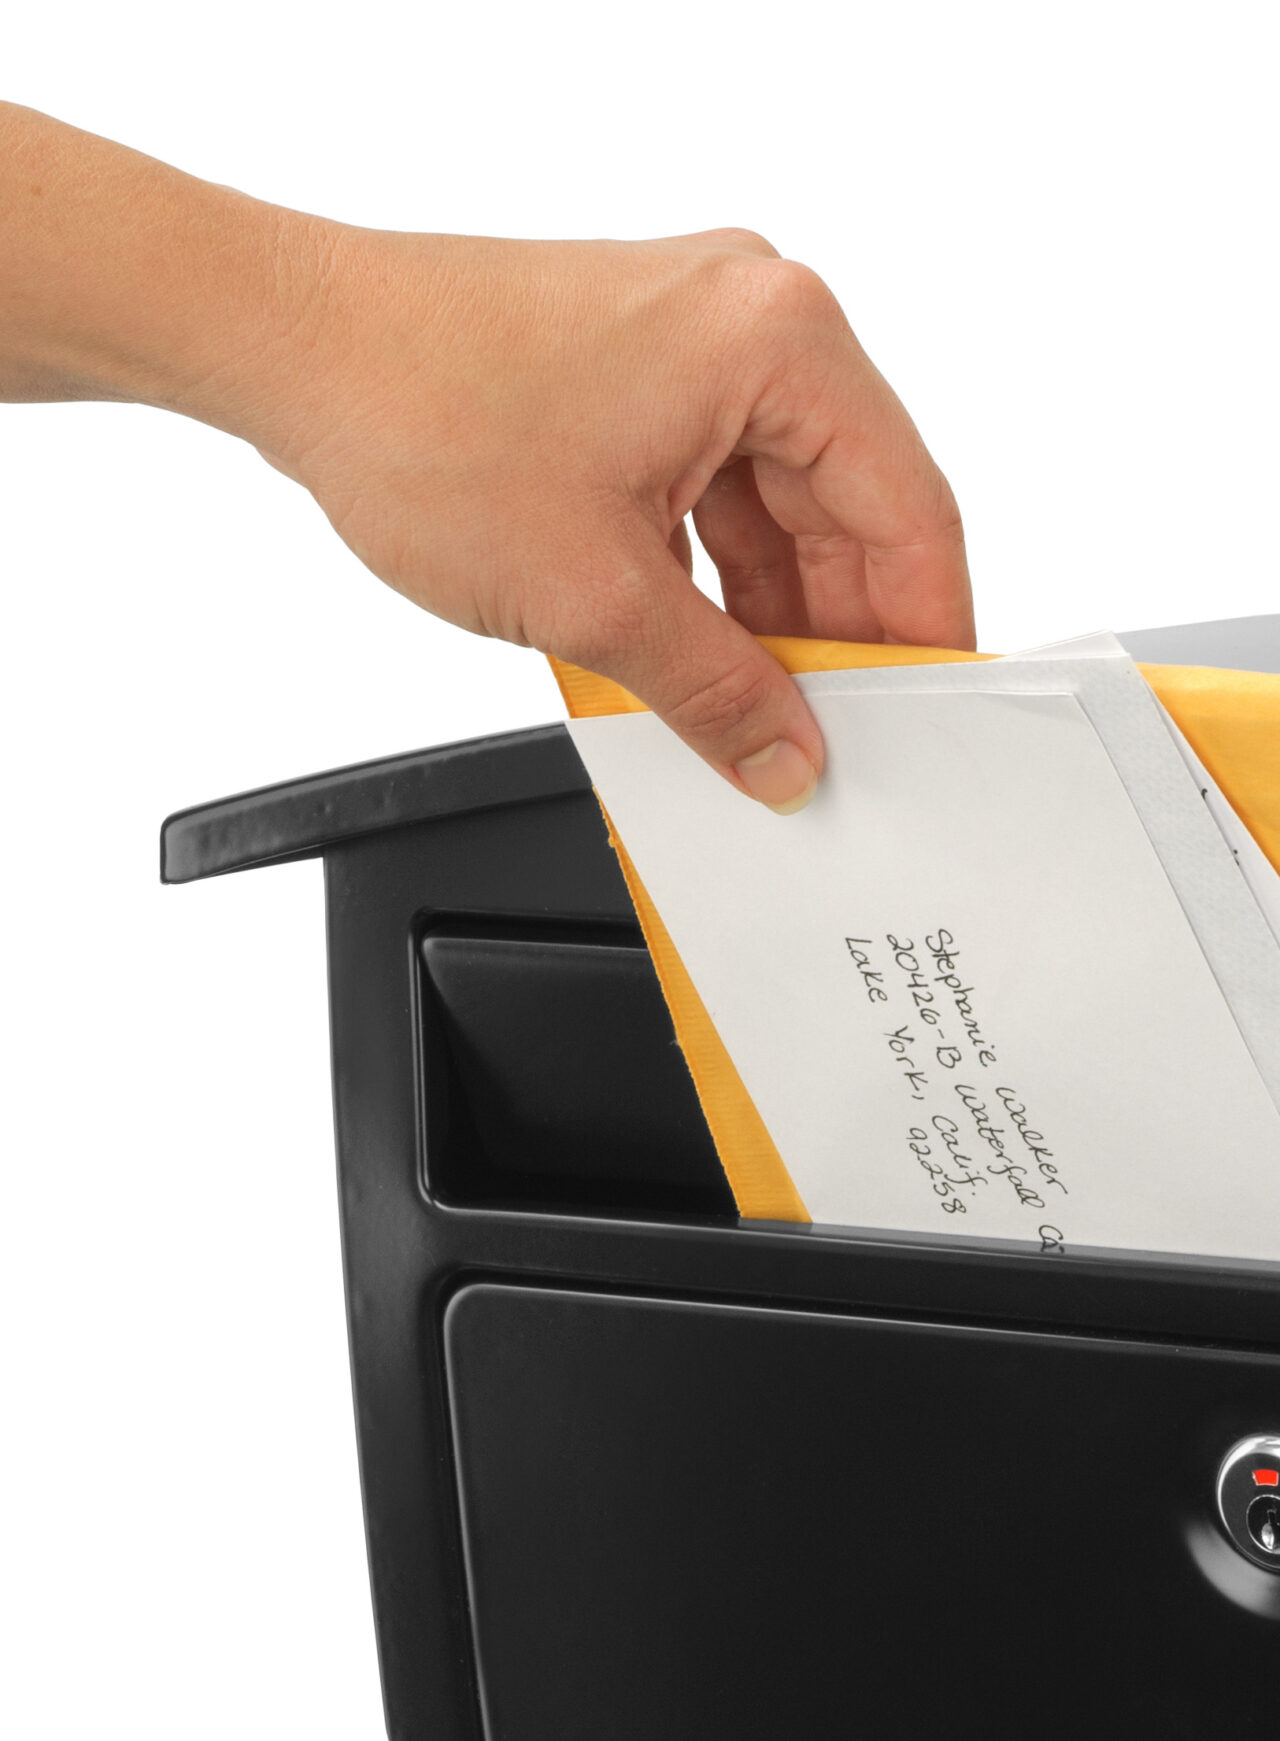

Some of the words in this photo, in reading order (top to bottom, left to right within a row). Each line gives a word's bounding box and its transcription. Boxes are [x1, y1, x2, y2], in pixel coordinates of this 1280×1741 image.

[845, 936, 888, 1003] Lake
[883, 1025, 929, 1101] York,
[886, 933, 962, 1069] 20426-B
[925, 928, 996, 1068] Stephanie
[905, 1127, 967, 1214] 92258
